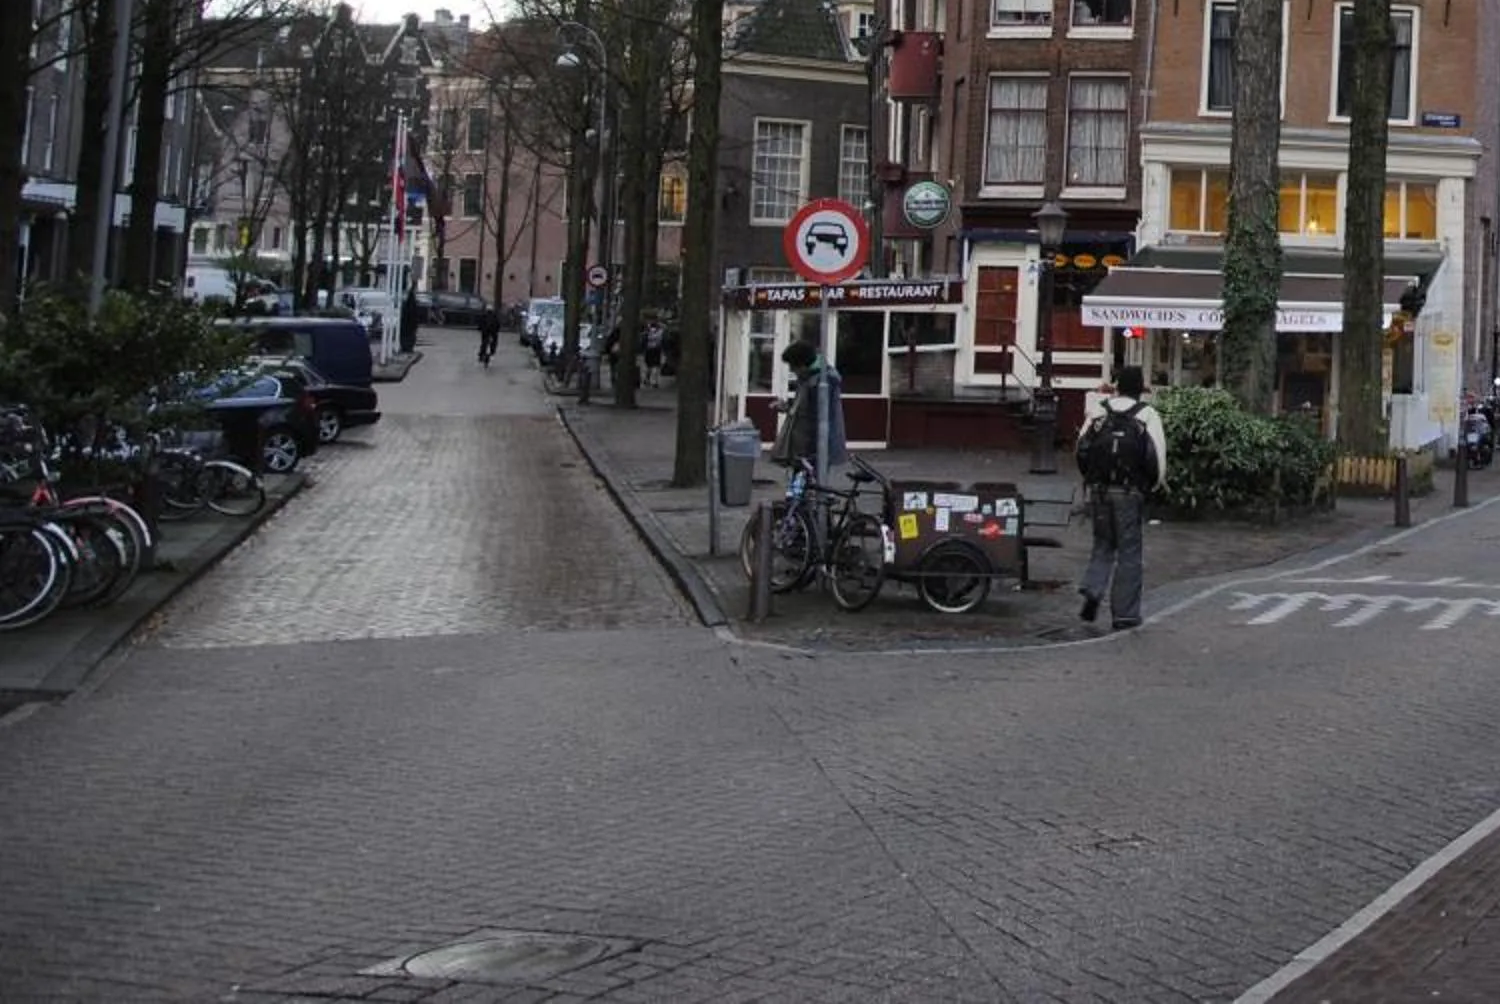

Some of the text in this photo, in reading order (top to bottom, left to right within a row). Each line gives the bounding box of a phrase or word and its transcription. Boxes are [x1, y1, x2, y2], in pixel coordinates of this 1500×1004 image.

[767, 288, 805, 301] TAPAS
[859, 285, 941, 299] RESTAURANT
[1091, 306, 1187, 322] SANDWICHES
